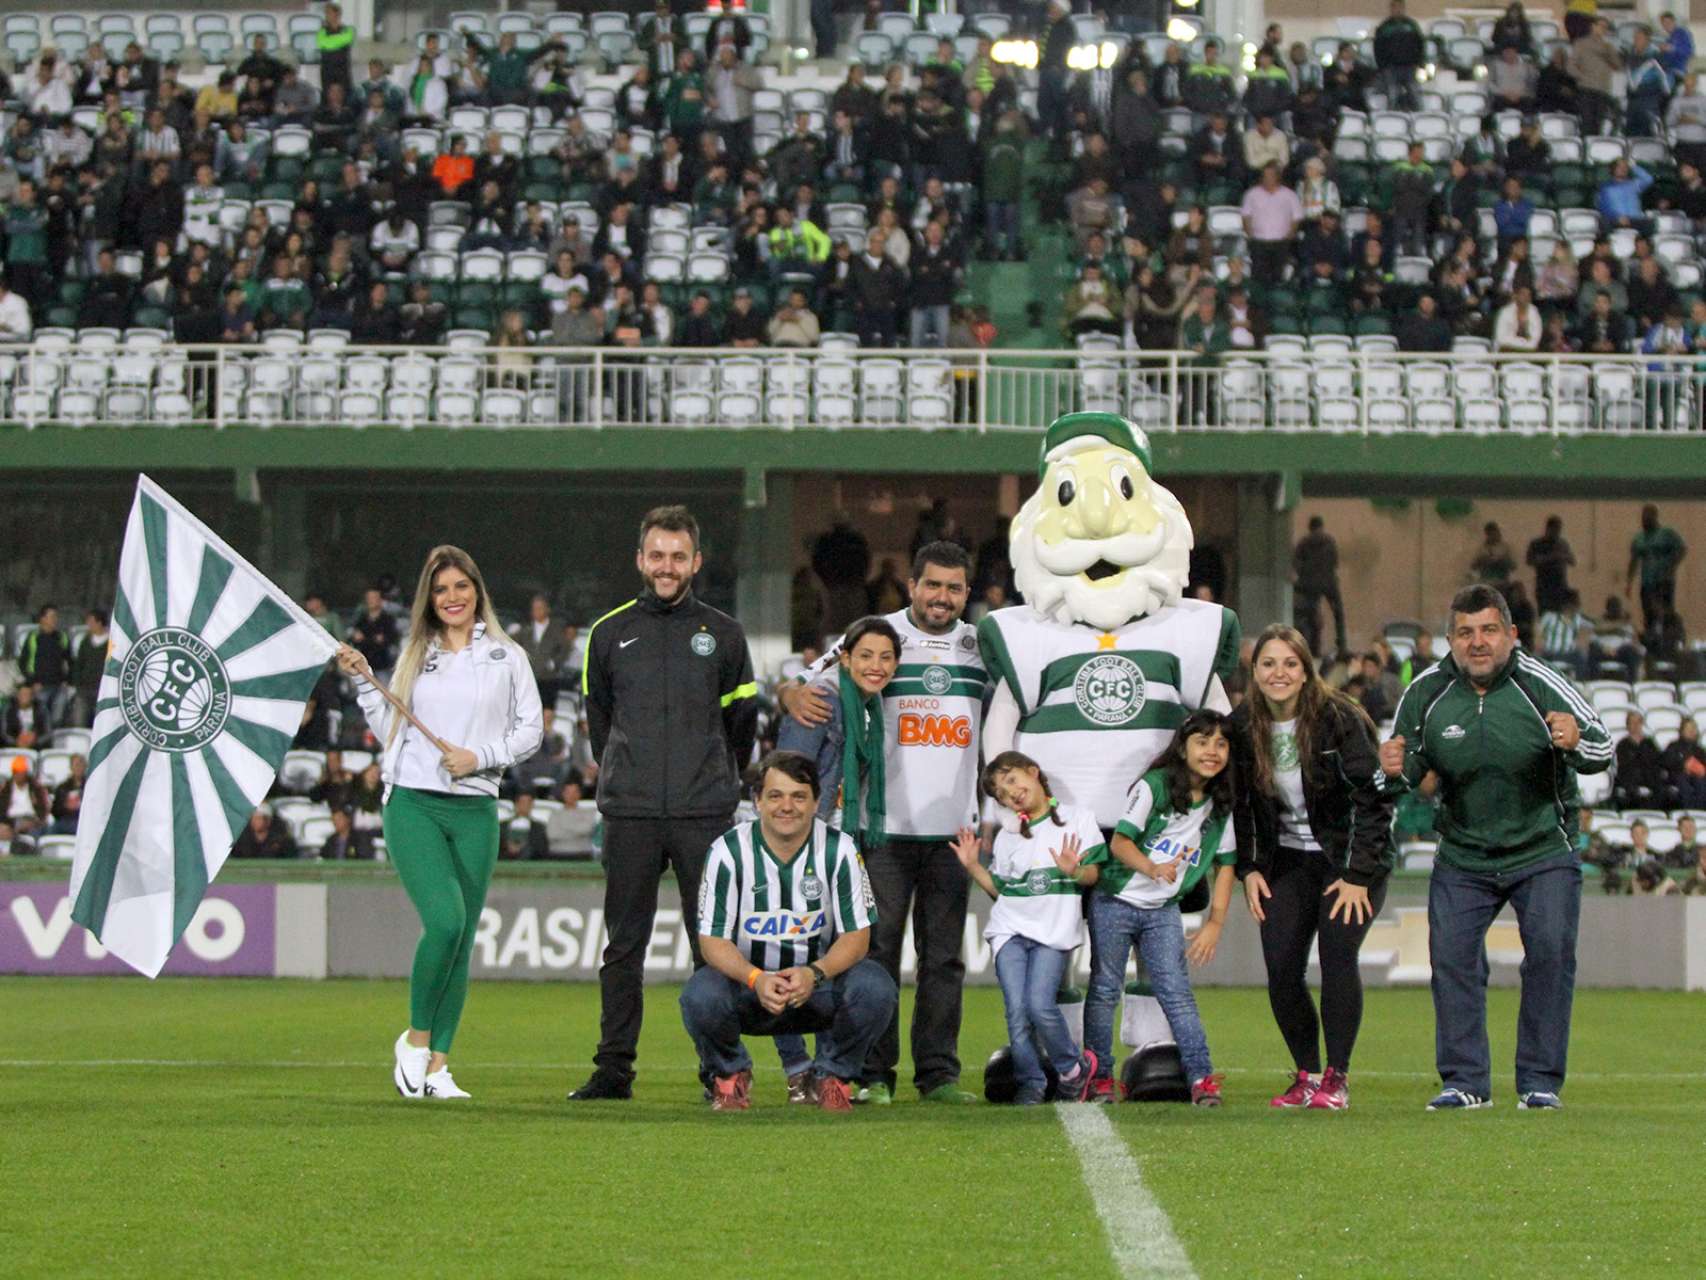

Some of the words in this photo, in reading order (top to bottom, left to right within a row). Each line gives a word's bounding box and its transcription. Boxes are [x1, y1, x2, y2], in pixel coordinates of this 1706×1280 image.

[140, 632, 174, 655] BALL
[177, 633, 211, 662] CLUB
[123, 652, 142, 691] FOOT
[151, 658, 196, 721] CFC
[898, 699, 940, 710] BANCO
[1088, 681, 1132, 698] CFC
[124, 694, 168, 746] CORITIBA
[898, 713, 972, 748] BMG
[11, 895, 245, 961] vo
[743, 911, 827, 936] CAIXA
